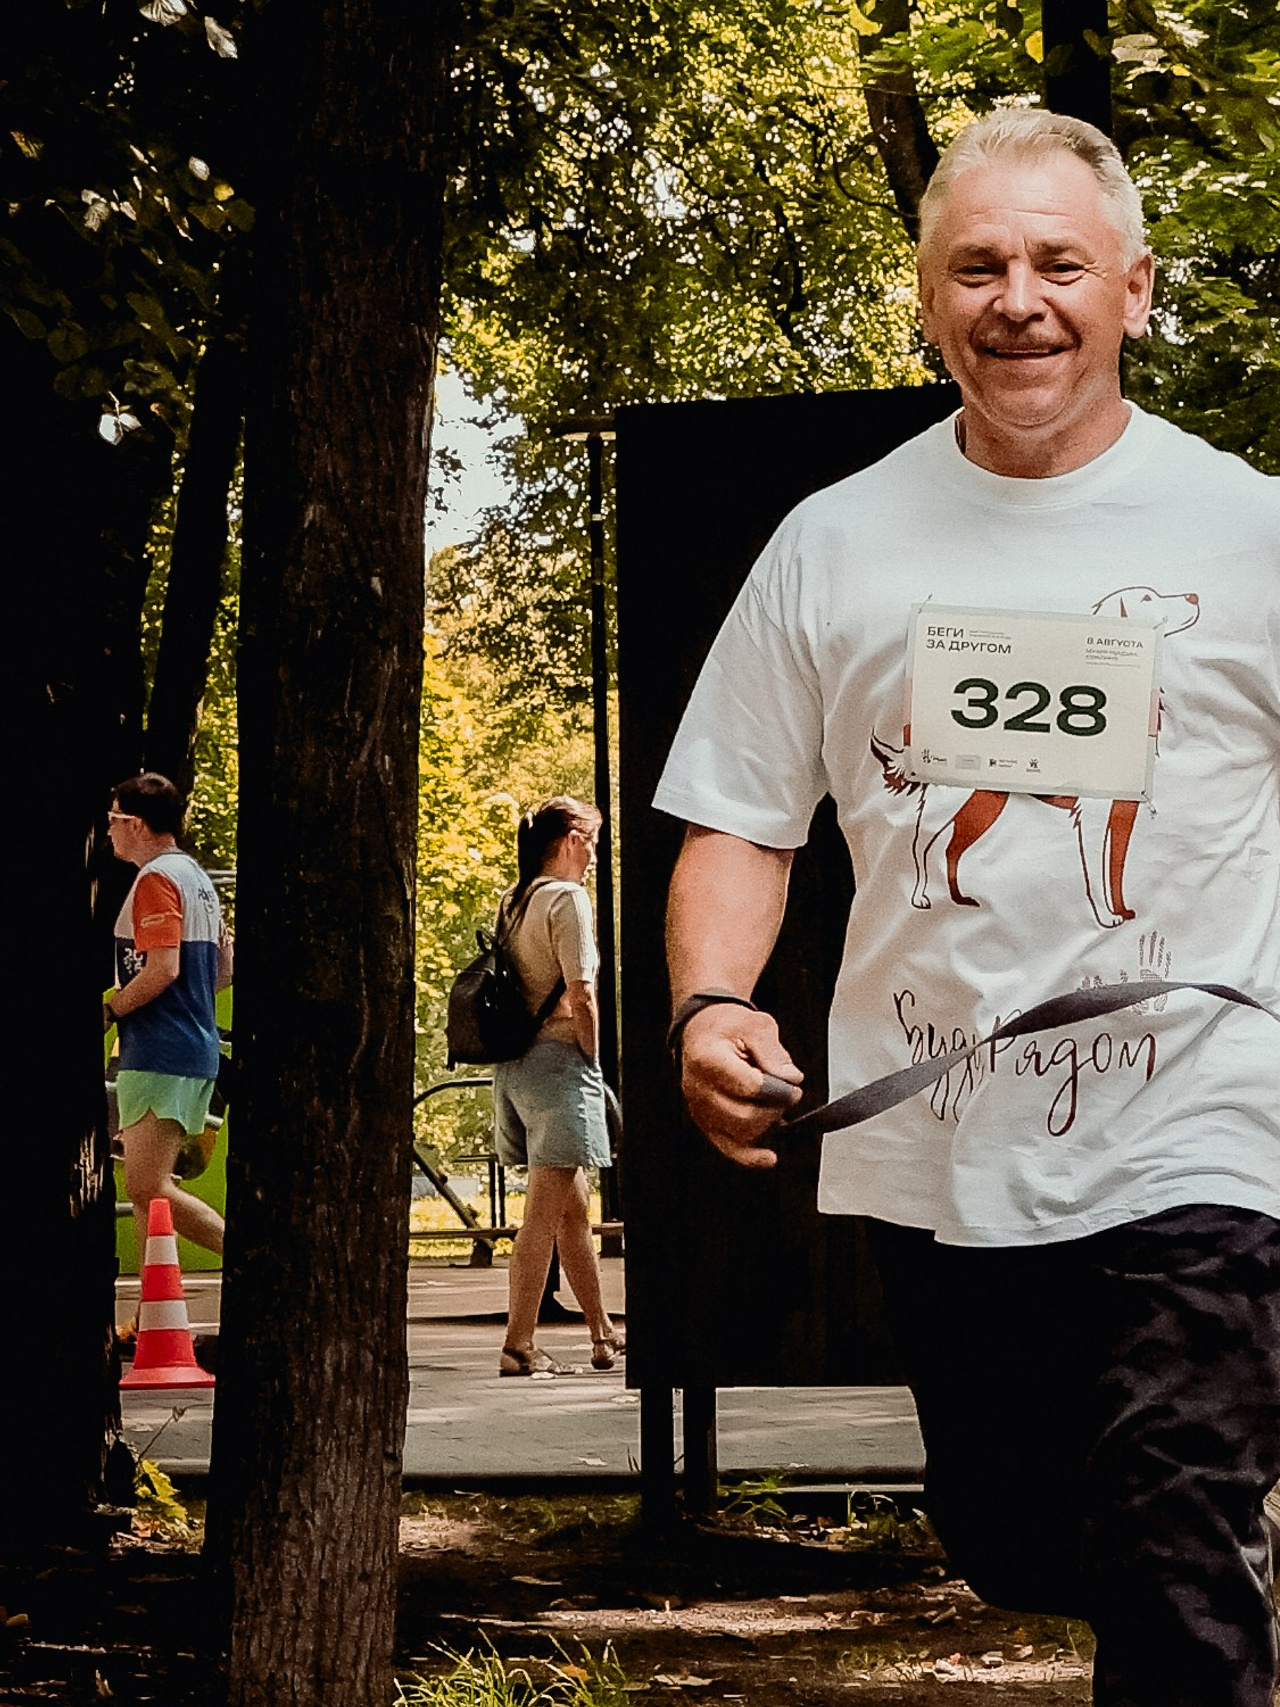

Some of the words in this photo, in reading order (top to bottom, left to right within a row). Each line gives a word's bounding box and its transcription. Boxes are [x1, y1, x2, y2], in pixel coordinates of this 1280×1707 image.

[927, 626, 964, 638] БЕГИ
[926, 639, 946, 650] ЗА
[948, 640, 1012, 654] ДРУГОМ
[1096, 637, 1144, 649] АВГУСТА
[950, 677, 1107, 737] 328
